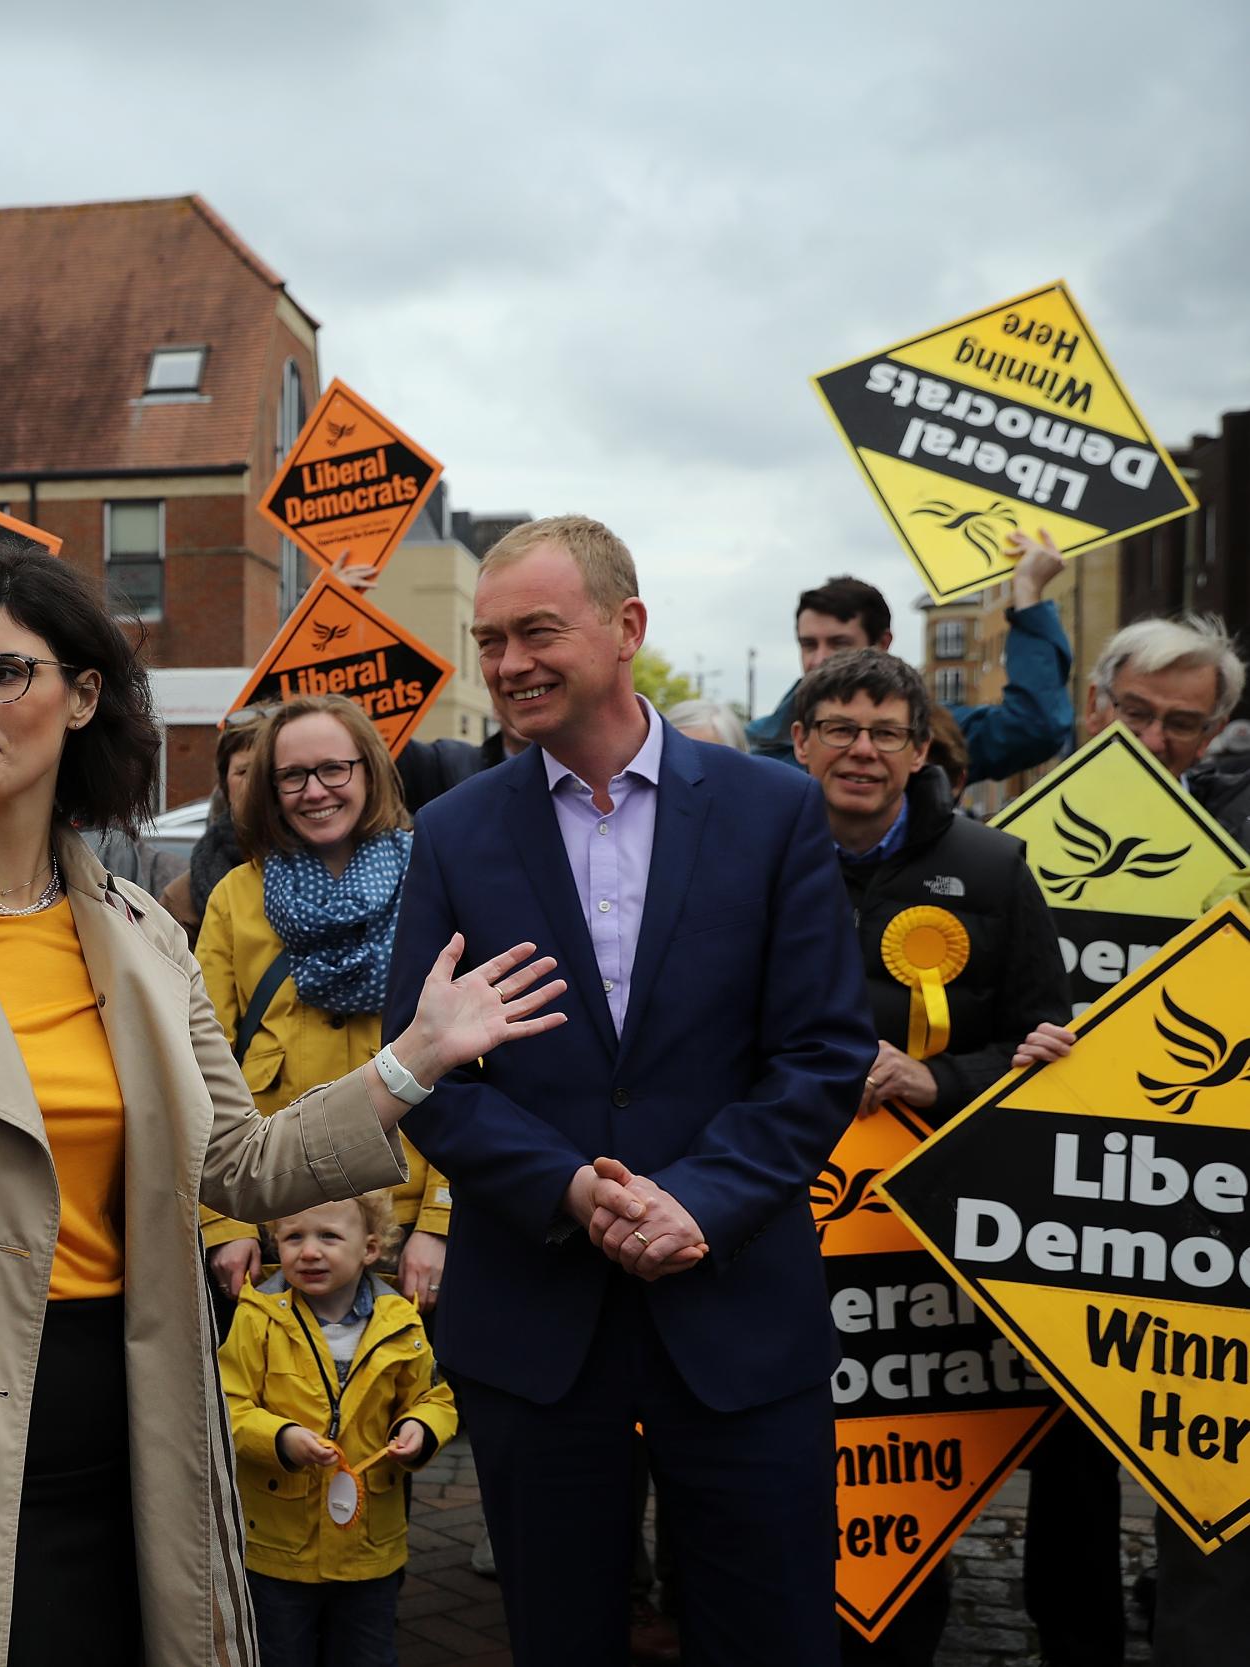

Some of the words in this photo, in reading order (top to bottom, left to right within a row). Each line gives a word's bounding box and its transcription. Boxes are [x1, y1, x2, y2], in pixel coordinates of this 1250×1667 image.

[1002, 311, 1079, 363] Here
[954, 336, 1094, 414] Winning
[864, 361, 1160, 491] Democrats
[301, 447, 388, 494] Liberal
[897, 416, 1090, 511] Liberal
[284, 473, 419, 526] Democrats
[279, 650, 387, 704] Liberal
[1053, 1131, 1248, 1213] Libe
[954, 1197, 1250, 1288] Demo
[836, 1505, 921, 1560] ere
